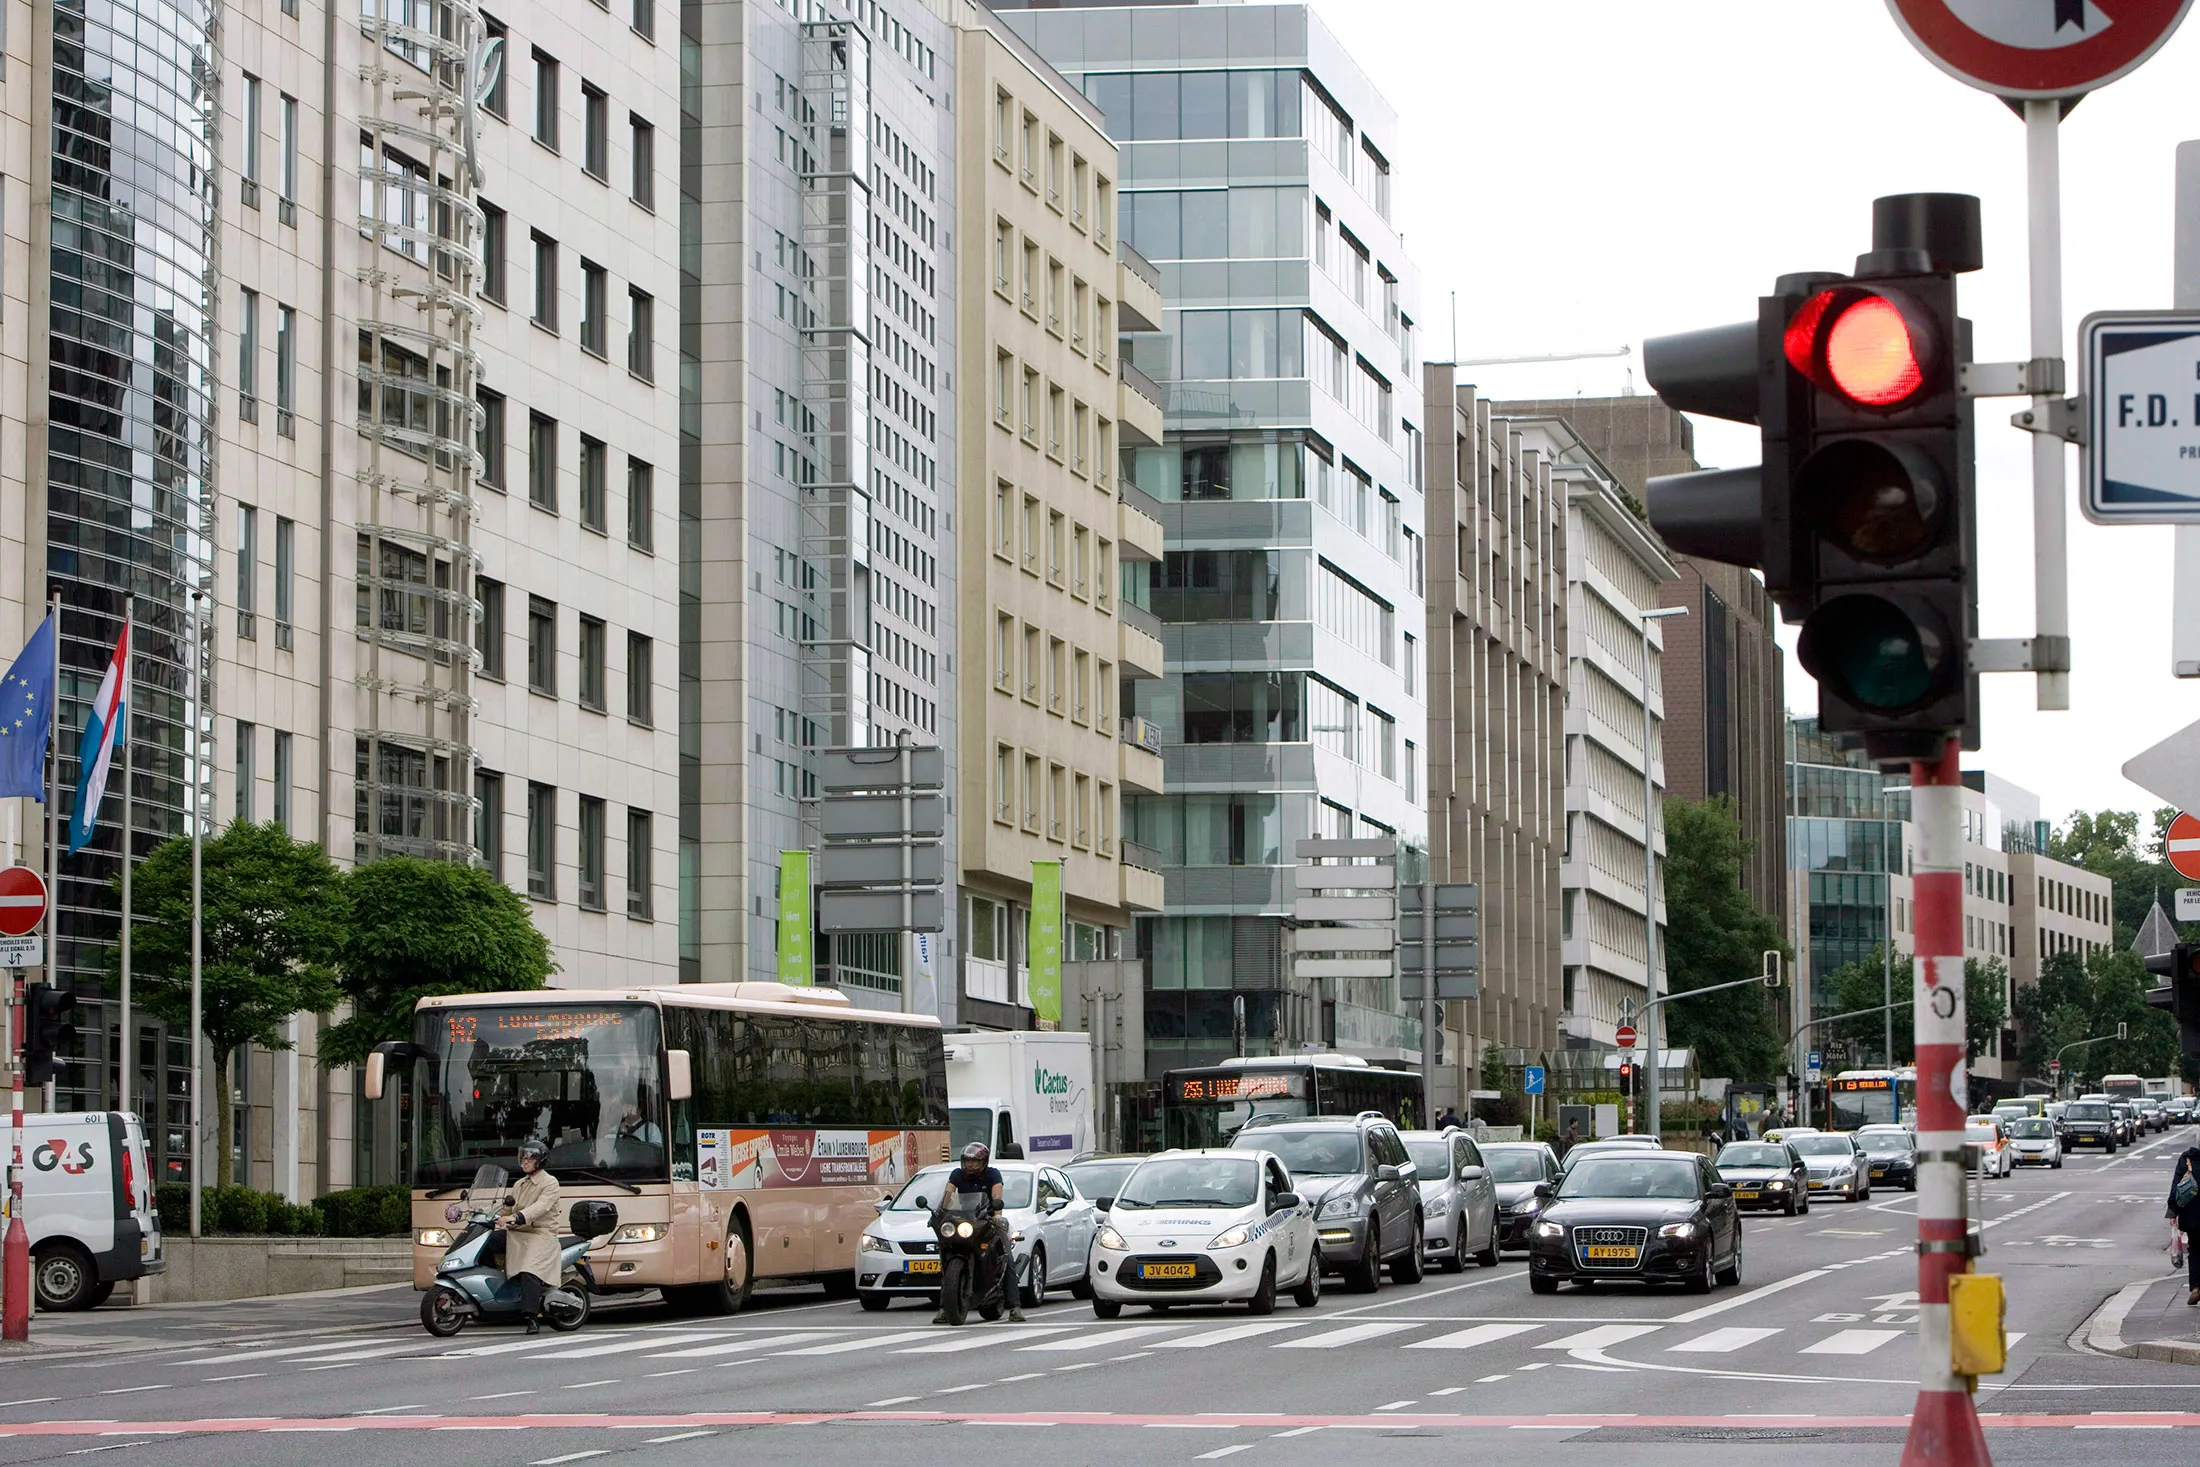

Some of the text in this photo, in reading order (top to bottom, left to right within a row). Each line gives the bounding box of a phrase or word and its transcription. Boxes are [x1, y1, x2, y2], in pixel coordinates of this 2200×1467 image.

[2118, 393, 2178, 428] F.D.
[1042, 1068, 1068, 1094] Cactus
[1183, 1077, 1288, 1099] 255 LUXEMBOURG
[85, 1115, 101, 1124] 601
[32, 1139, 94, 1174] G4S
[1593, 1248, 1631, 1257] AY 1975
[913, 1261, 940, 1271] CU 47
[1149, 1266, 1191, 1276] JV 4042
[1808, 1311, 1921, 1324] BU
